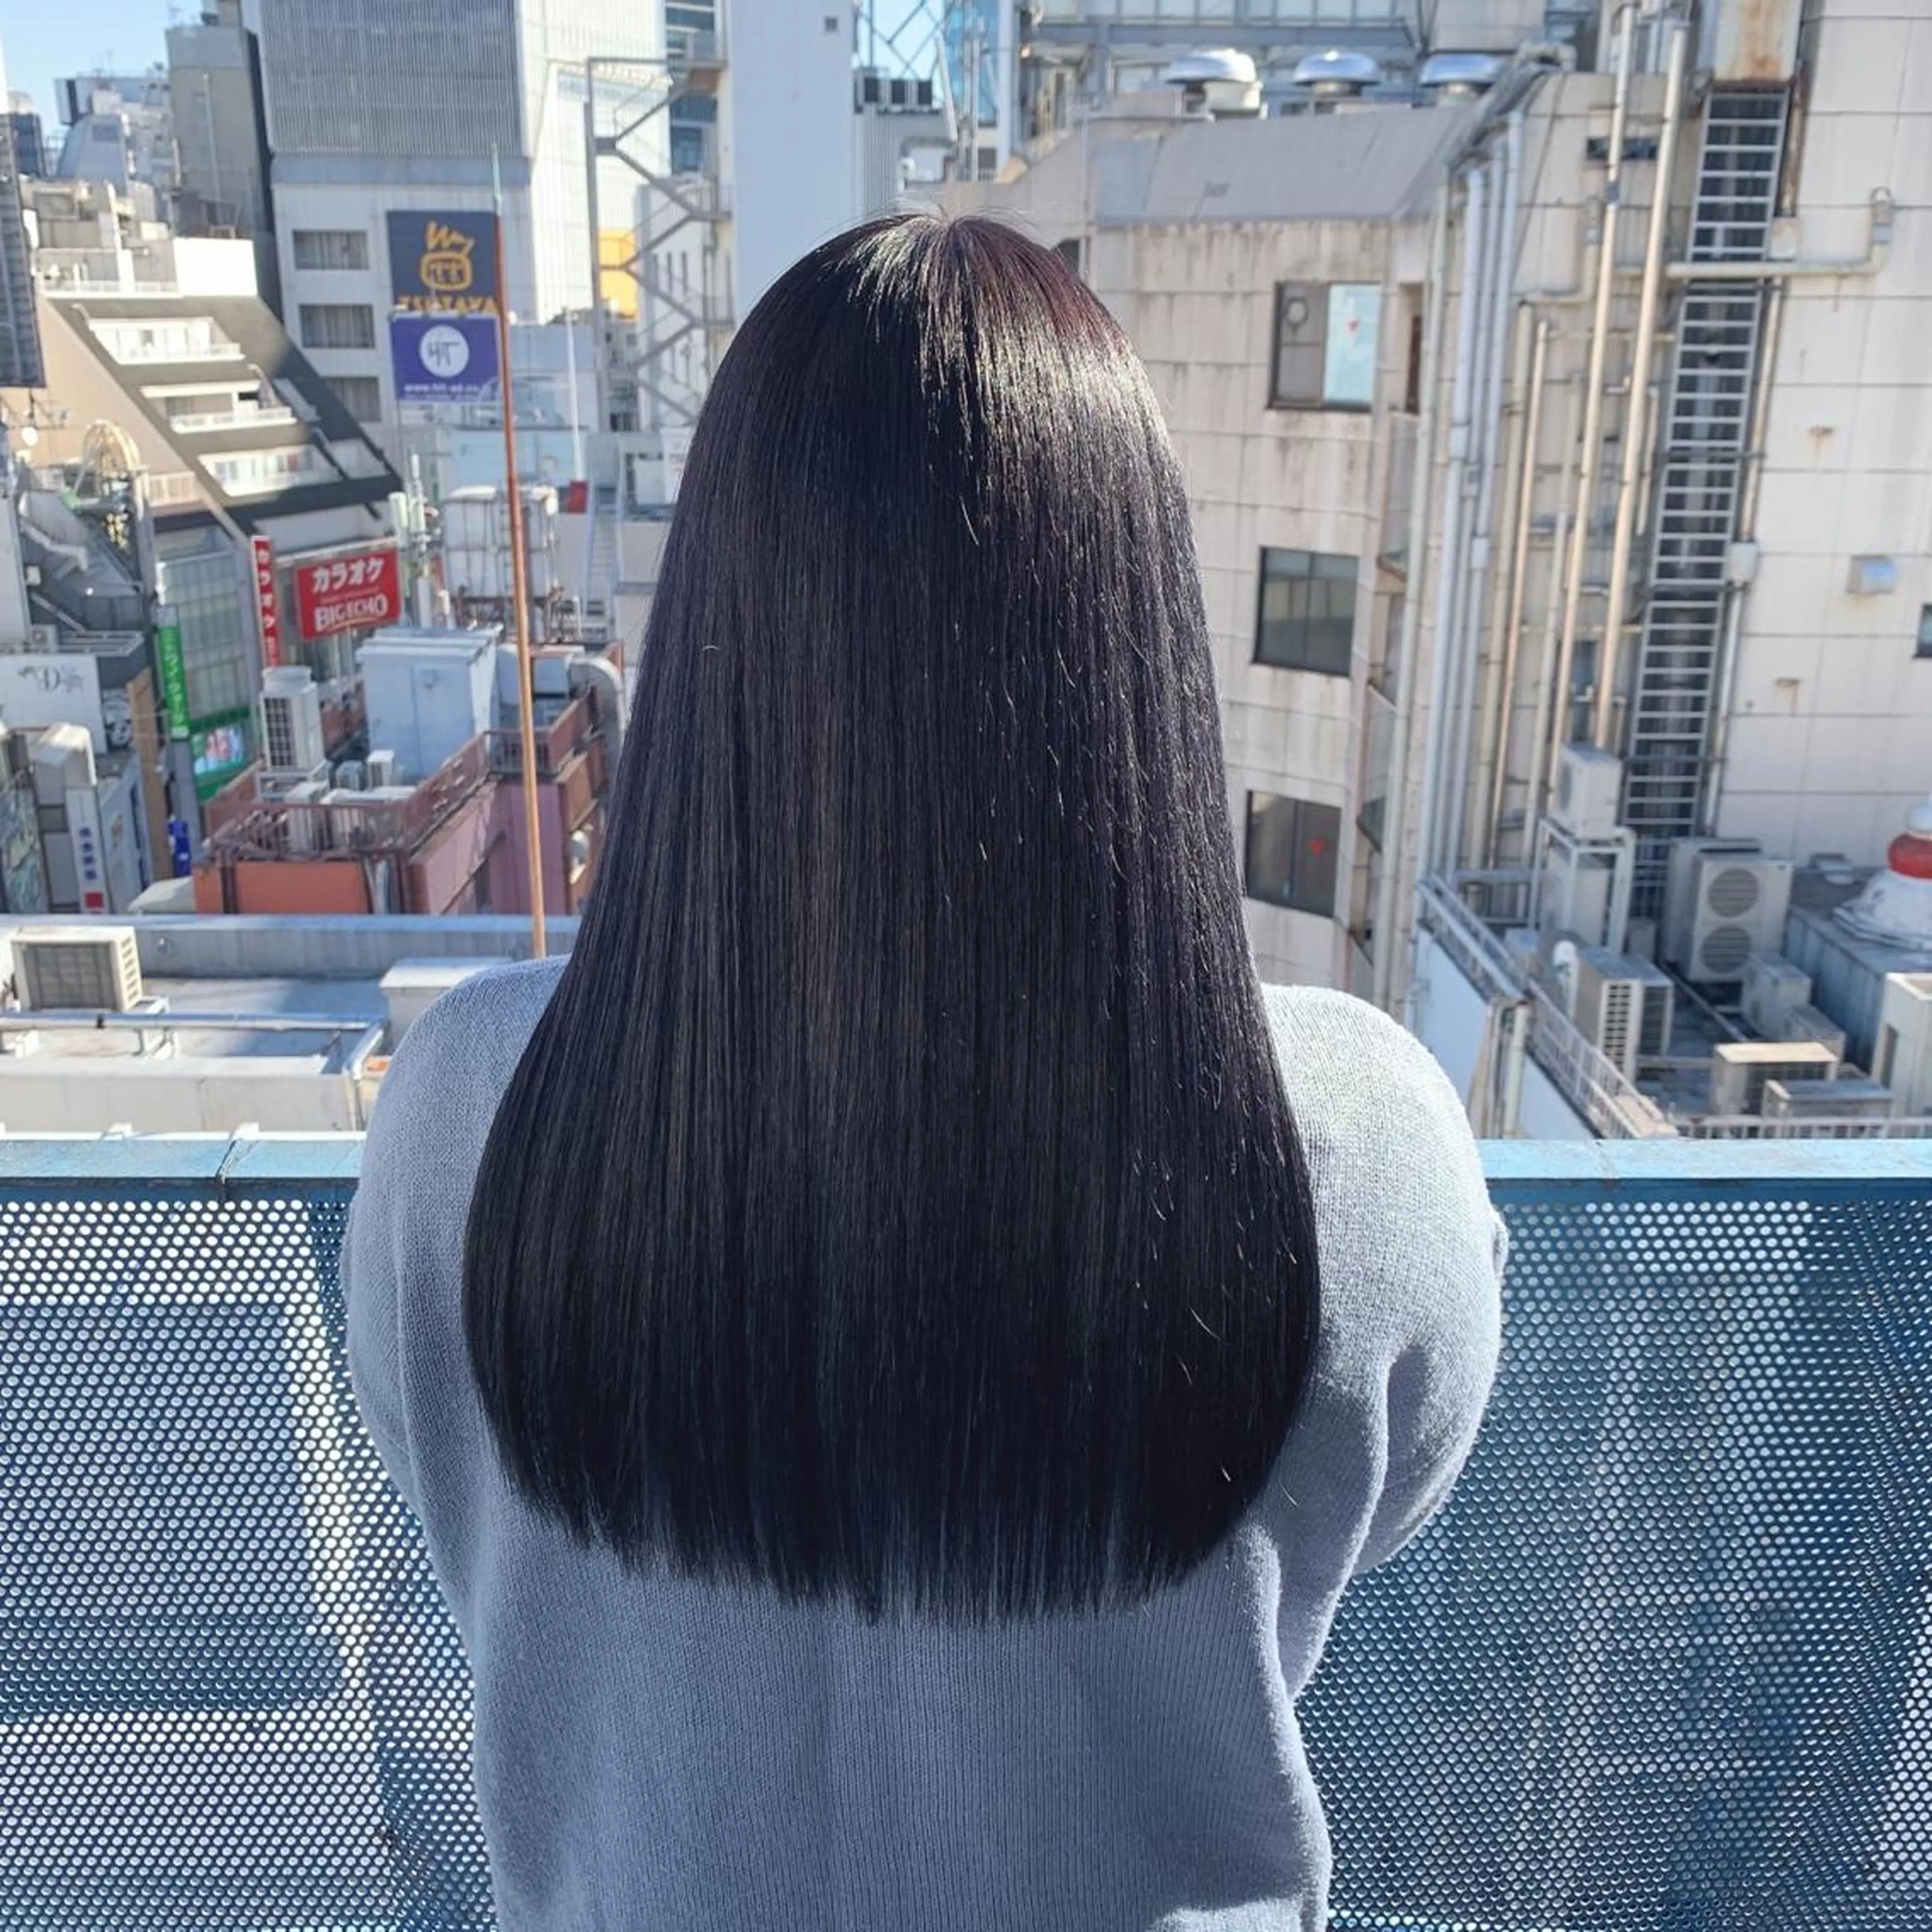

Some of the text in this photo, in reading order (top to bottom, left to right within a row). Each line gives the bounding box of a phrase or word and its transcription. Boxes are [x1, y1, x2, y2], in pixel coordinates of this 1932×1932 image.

[312, 557, 385, 594] カラオケ
[314, 603, 345, 633] BIG
[346, 593, 388, 618] ECHO
